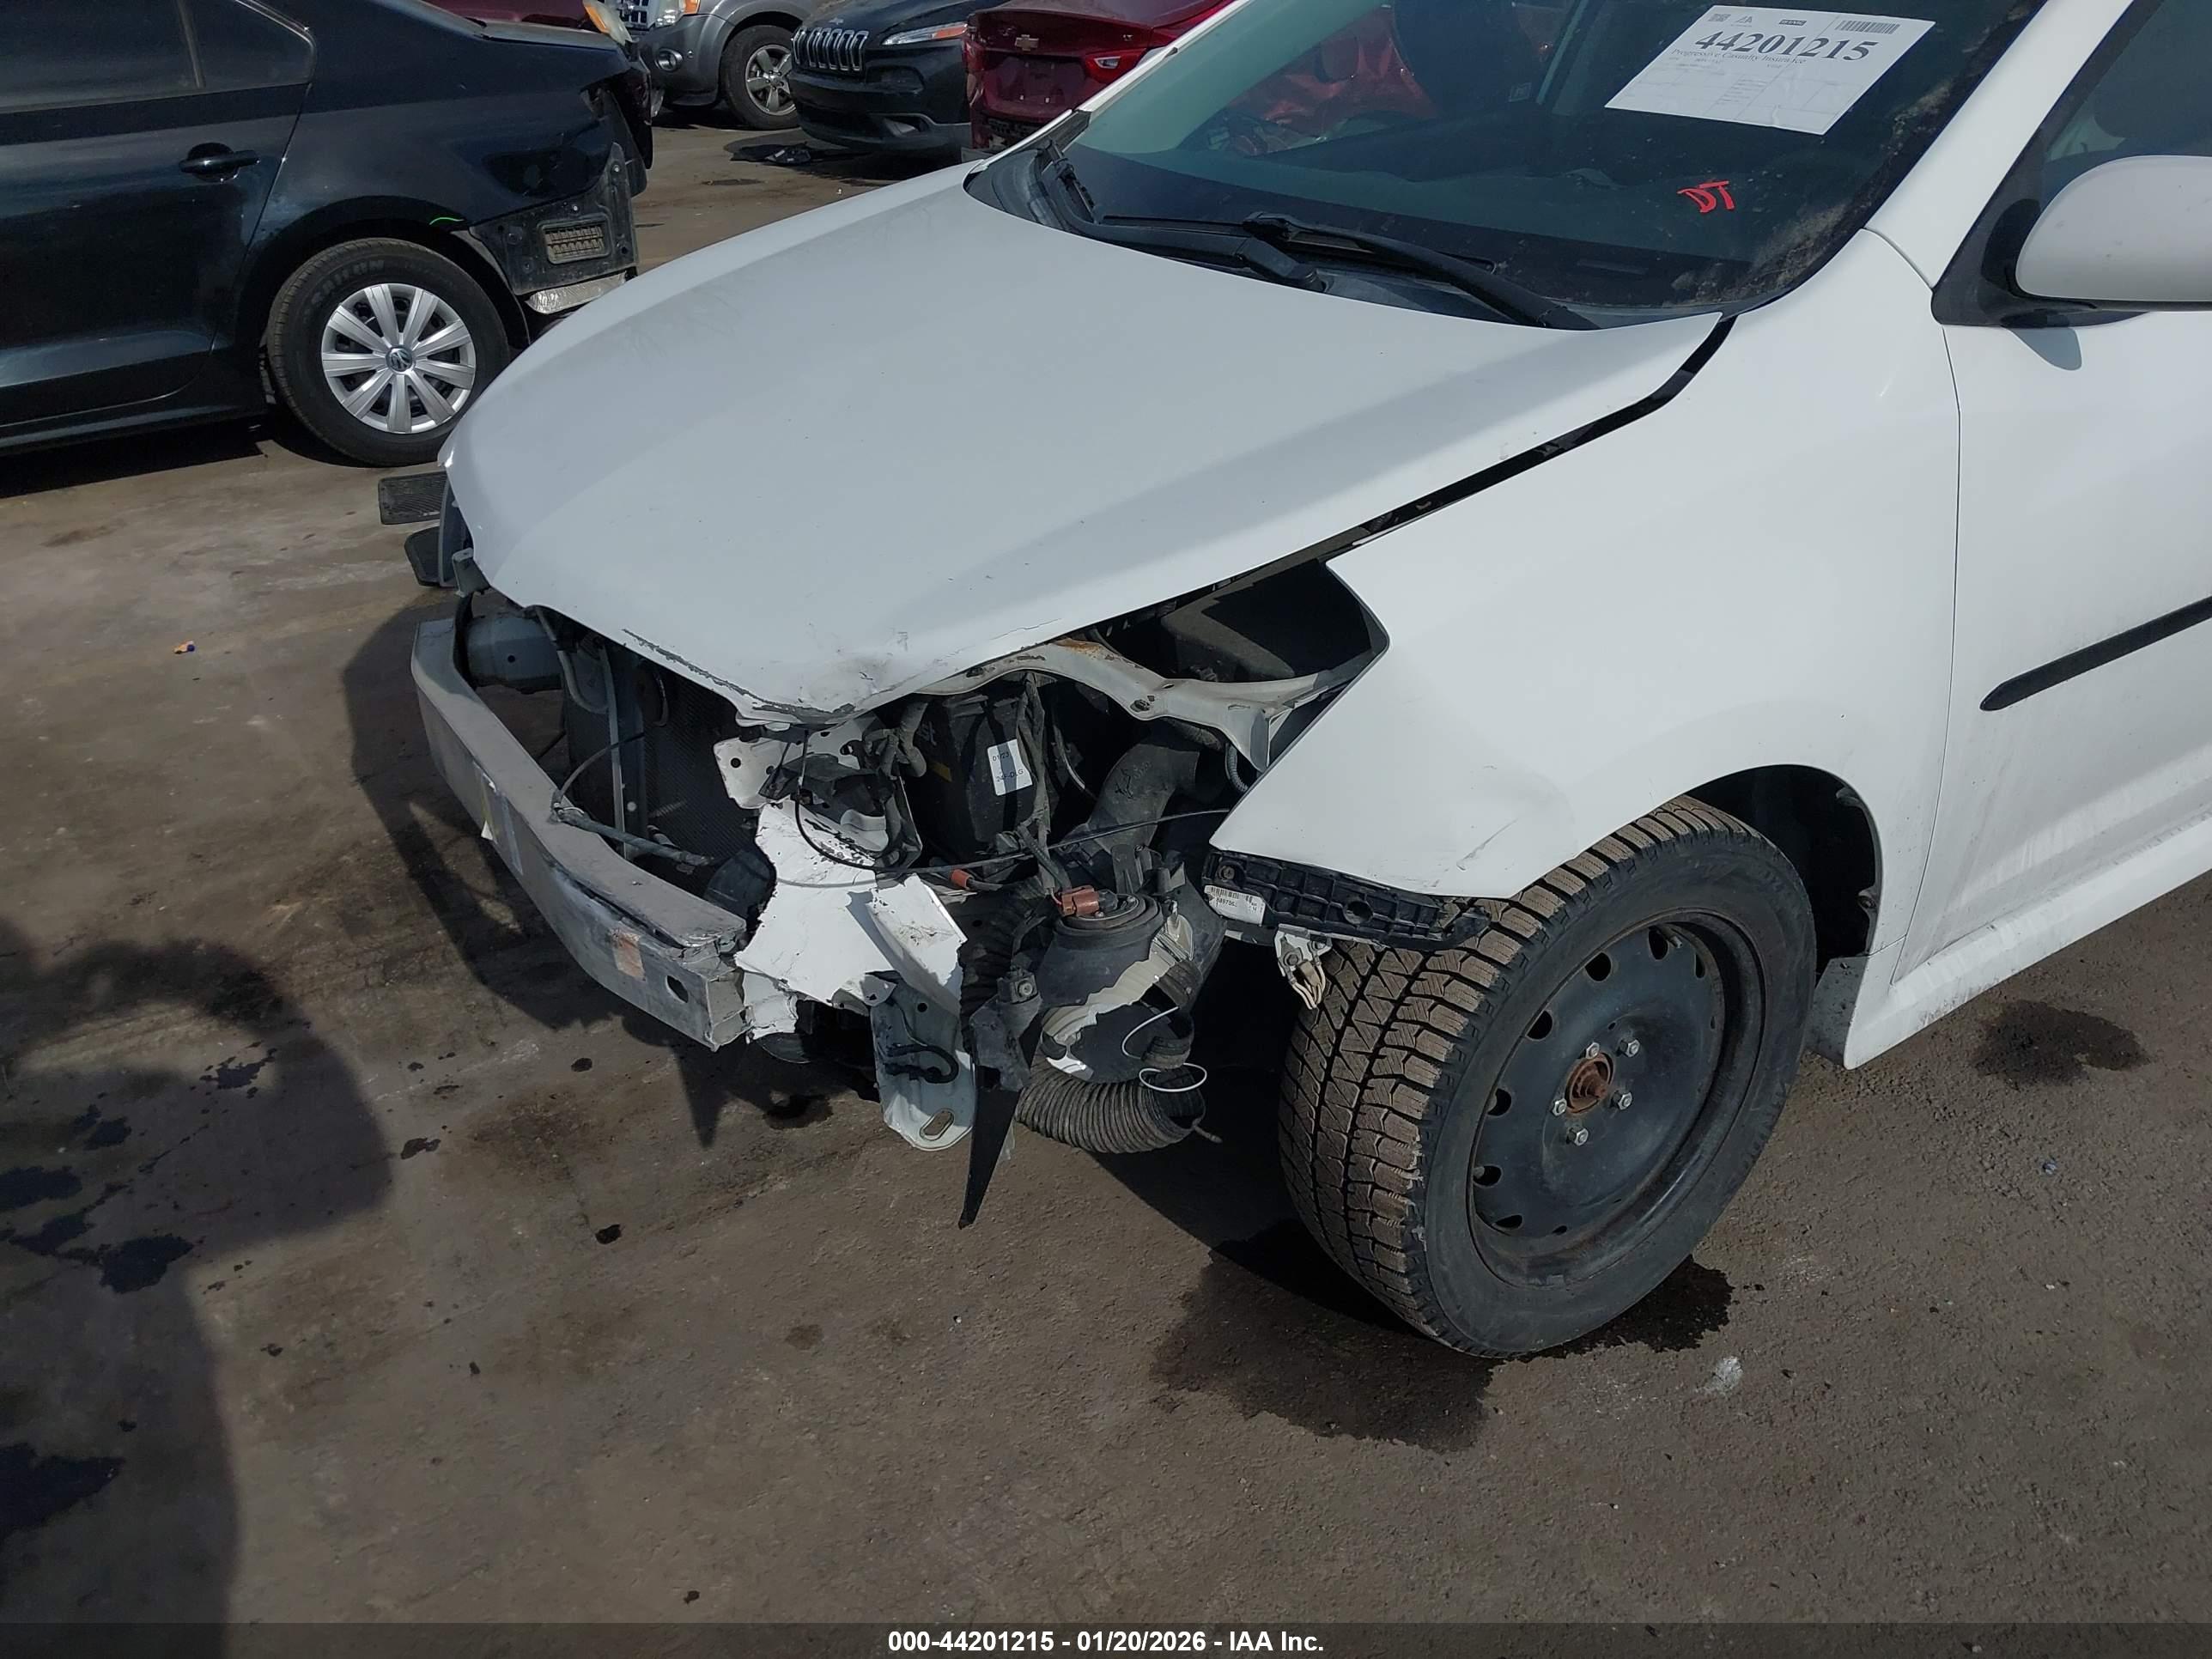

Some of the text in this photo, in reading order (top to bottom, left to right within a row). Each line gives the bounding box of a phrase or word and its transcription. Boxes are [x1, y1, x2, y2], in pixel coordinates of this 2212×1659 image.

[1671, 48, 1721, 58] Progressive
[1723, 52, 1759, 62] Casualty
[1695, 31, 1880, 62] 44201215
